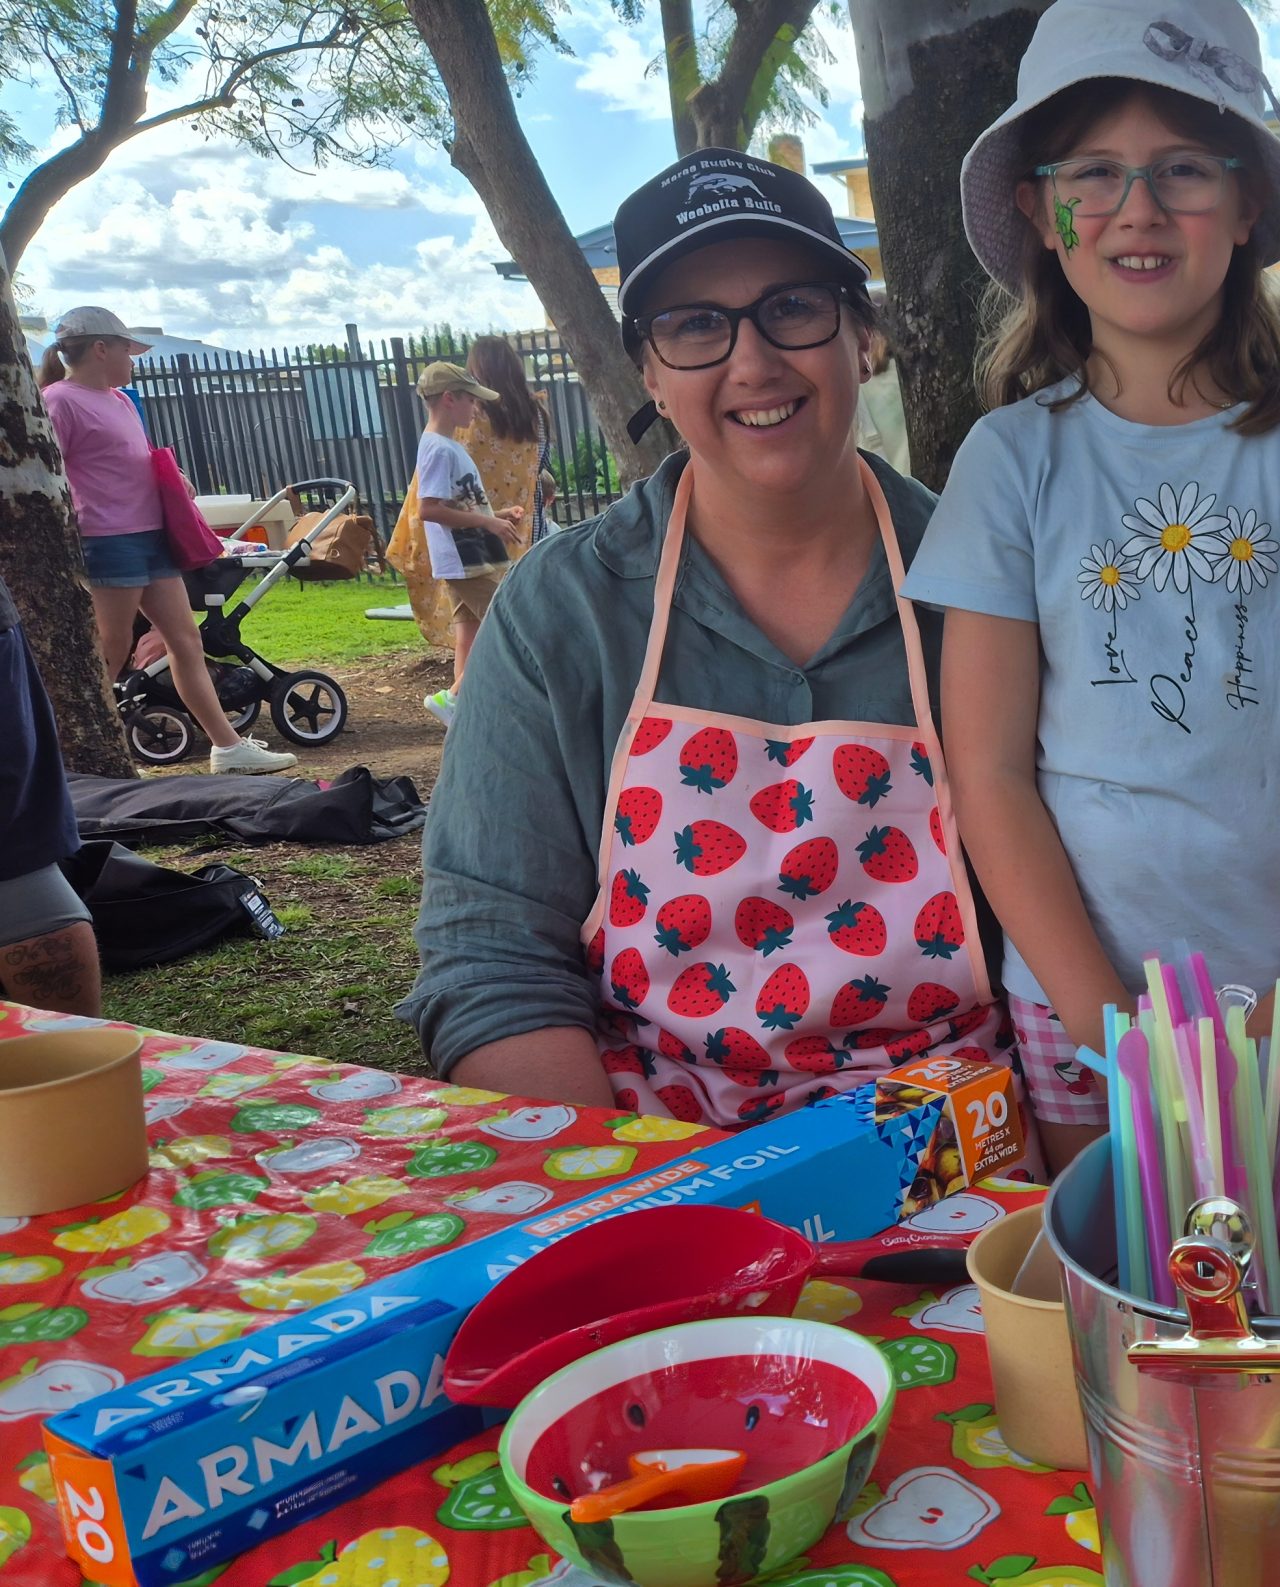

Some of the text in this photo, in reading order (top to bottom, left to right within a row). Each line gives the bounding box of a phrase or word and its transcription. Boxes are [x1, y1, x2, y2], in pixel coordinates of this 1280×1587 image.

[699, 158, 744, 170] Rugby
[746, 163, 777, 178] Club
[743, 197, 783, 214] Bulls
[1091, 632, 1138, 687] Love
[1150, 615, 1198, 735] Peace
[1226, 603, 1260, 711] Happiness
[906, 1060, 962, 1080] 20
[966, 1091, 1008, 1138] 20
[974, 1130, 1005, 1151] METRES
[974, 1143, 1018, 1171] EXTRA WIDE
[984, 1145, 994, 1155] 44
[708, 1144, 801, 1181] FOIL
[531, 1162, 701, 1233] EXTRA WIDE
[93, 1295, 424, 1436] ARMADA
[63, 1480, 114, 1564] 20
